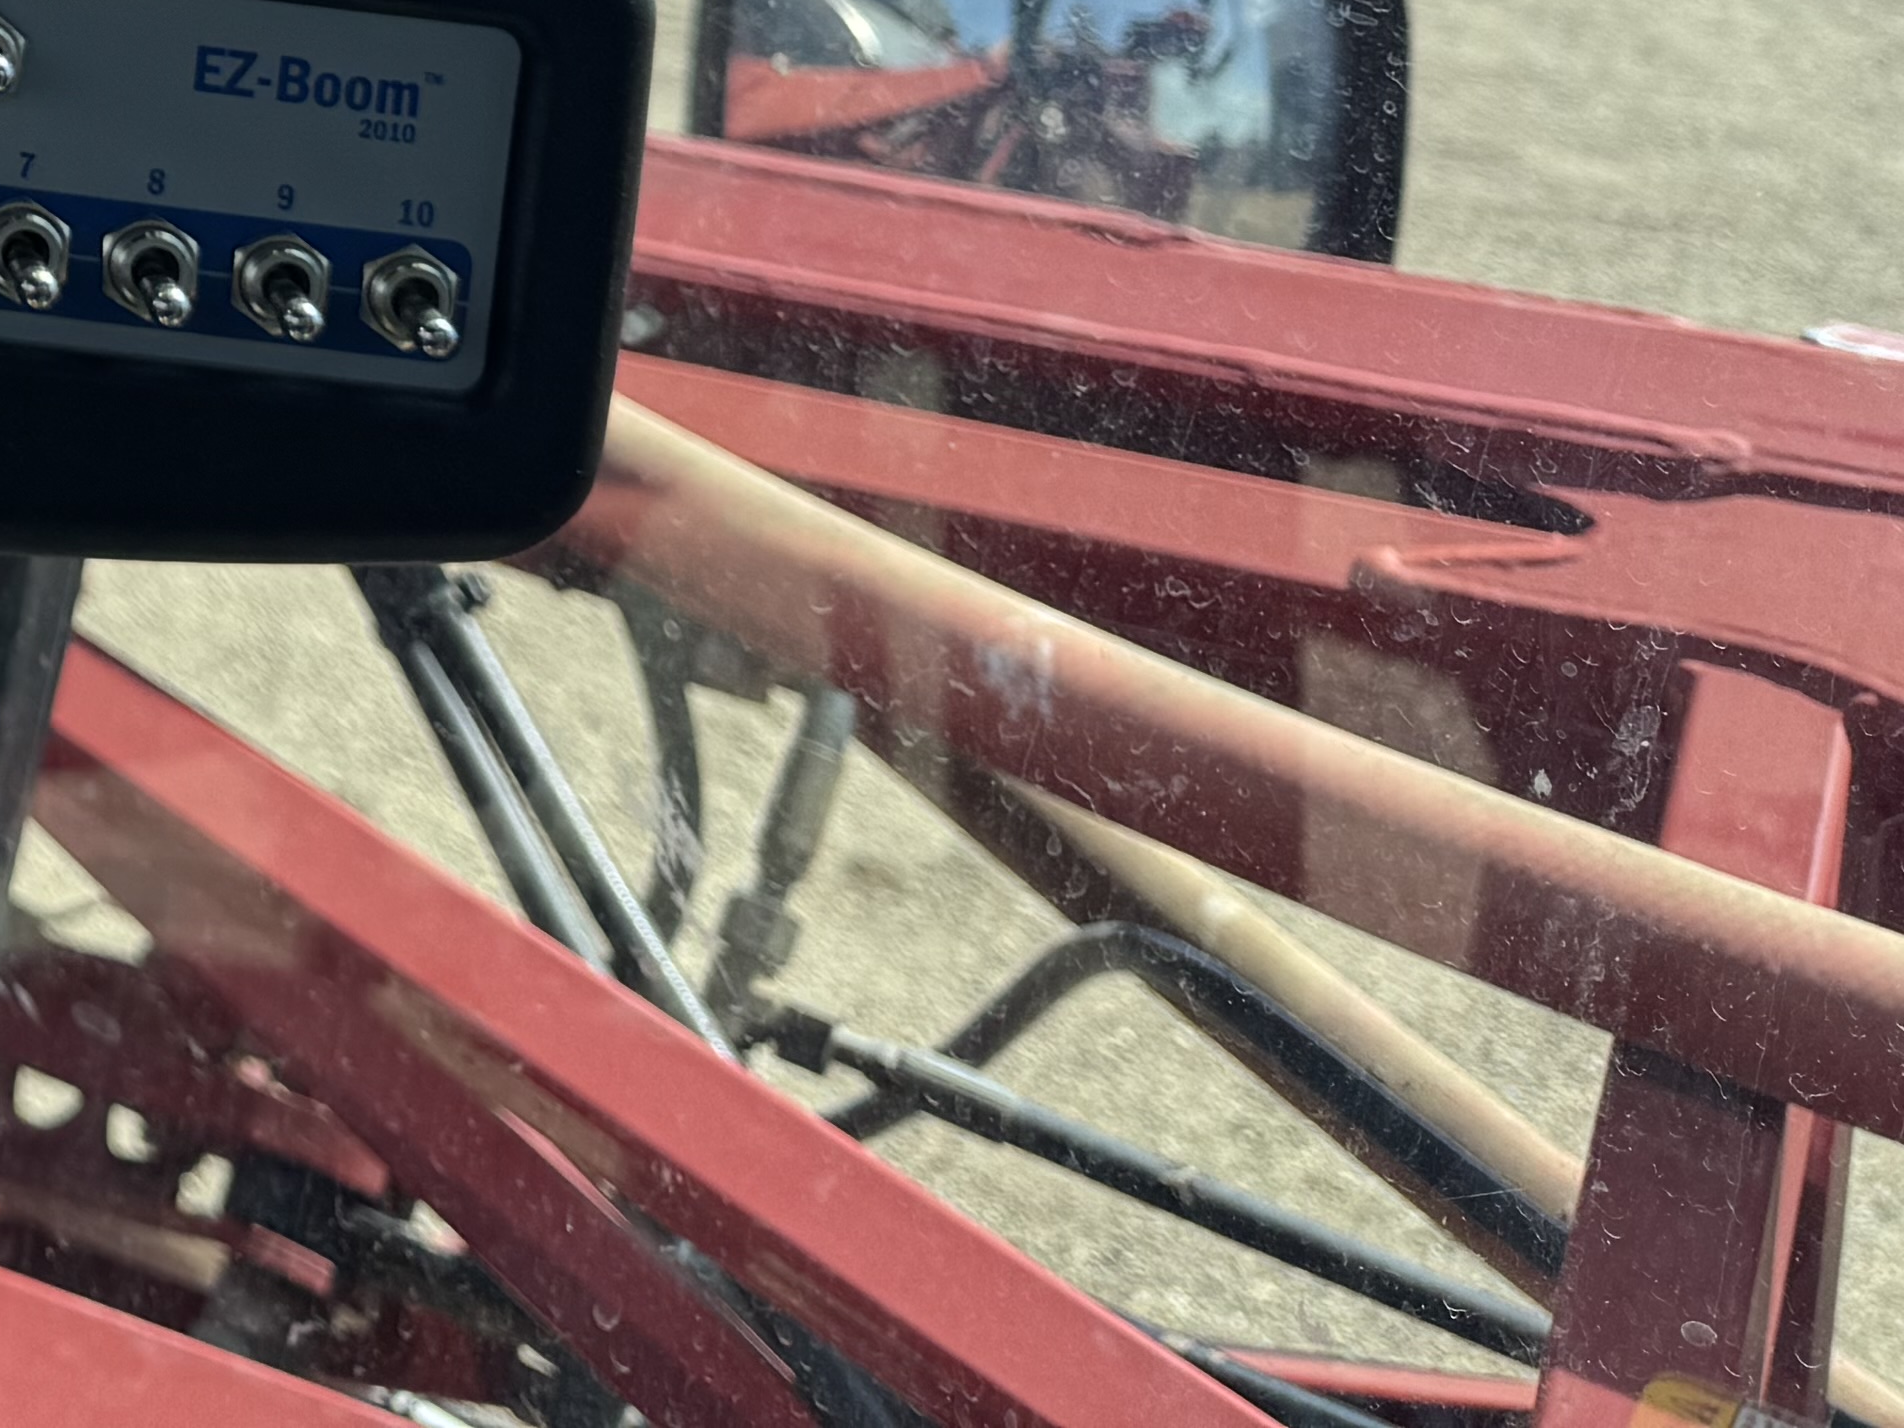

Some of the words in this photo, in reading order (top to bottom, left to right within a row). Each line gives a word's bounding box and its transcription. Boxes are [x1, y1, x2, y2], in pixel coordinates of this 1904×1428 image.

[359, 118, 416, 145] 2010
[19, 151, 36, 179] 7
[148, 168, 166, 195] 8
[277, 184, 294, 211] 9
[399, 198, 435, 228] 10
